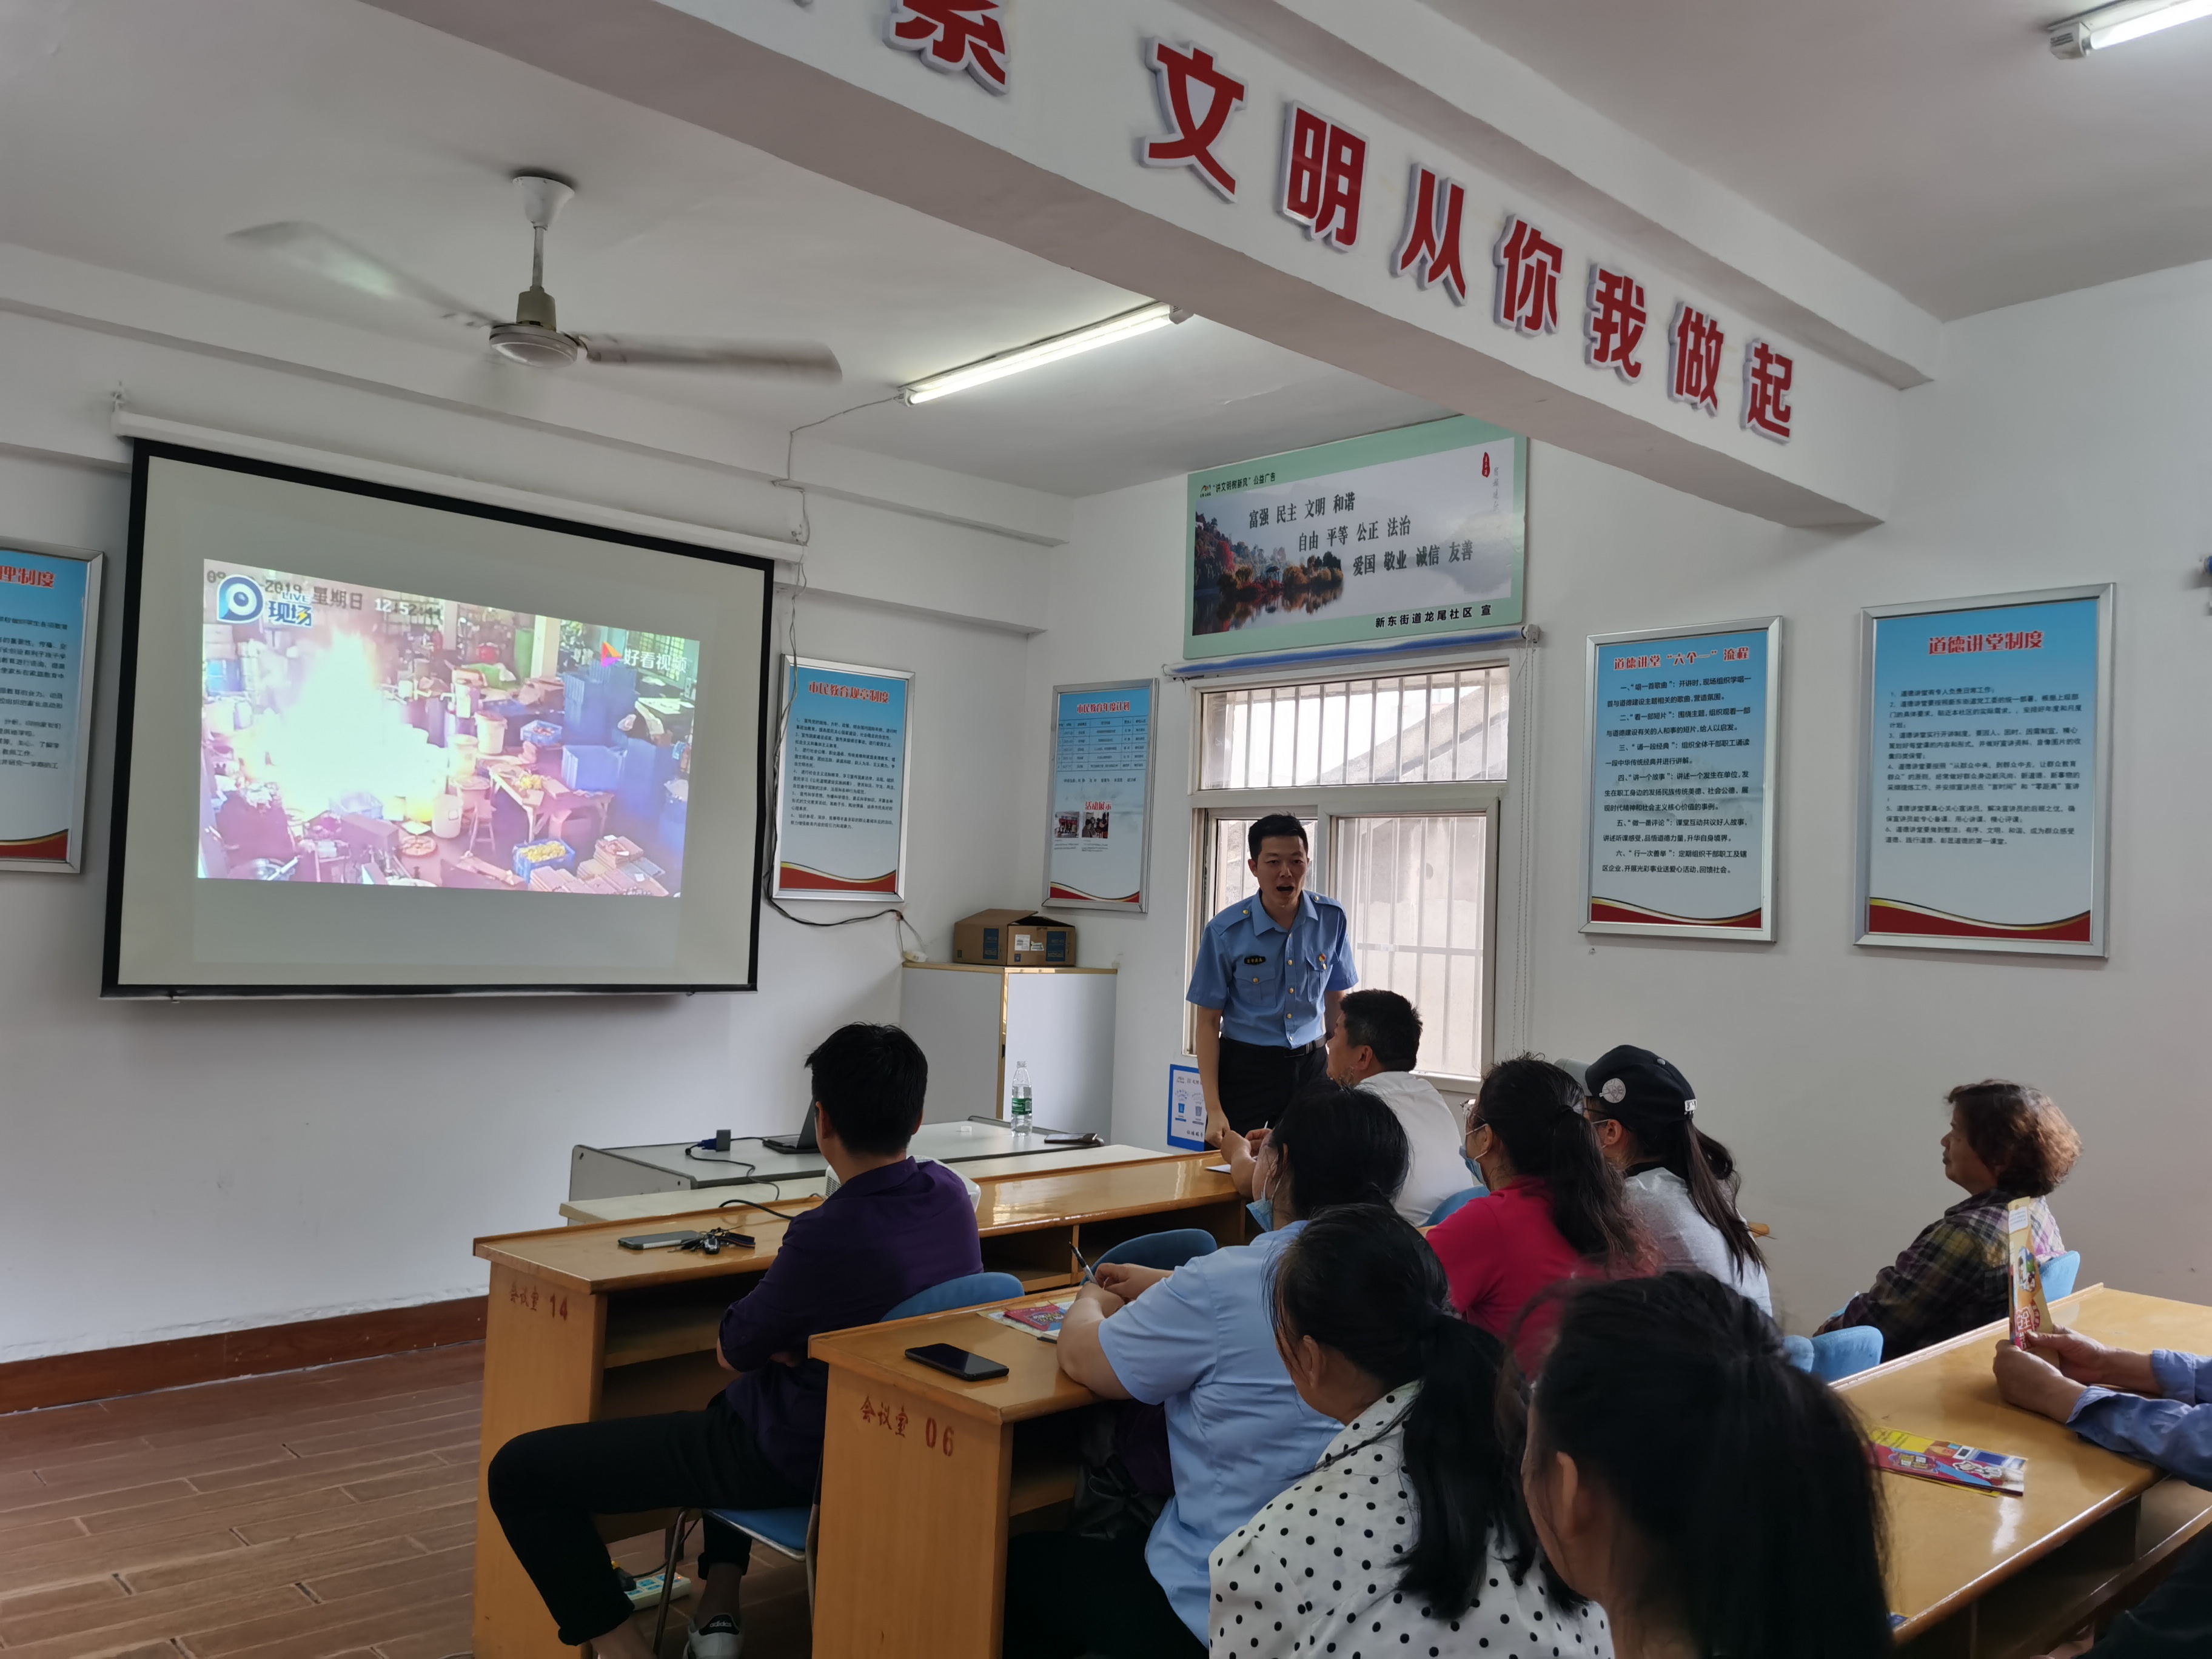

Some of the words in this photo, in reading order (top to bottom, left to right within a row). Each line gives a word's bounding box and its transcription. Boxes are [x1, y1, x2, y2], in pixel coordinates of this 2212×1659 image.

[1144, 40, 1795, 440] 文明从你我做起
[1249, 508, 1269, 529] 富强
[1276, 503, 1297, 524] 民主
[1304, 497, 1326, 520] 文明
[1333, 492, 1355, 514] 和谐
[1299, 531, 1319, 552] 自由
[1327, 525, 1349, 547] 平等
[1356, 520, 1379, 542] 公正
[1387, 515, 1411, 537] 法治
[1352, 554, 1375, 577] 爱国
[1384, 550, 1407, 571] 敬业
[1415, 545, 1440, 568] 诚信
[1448, 539, 1473, 563] 友善
[281, 592, 311, 602] LIVE
[312, 586, 363, 610] 星期日
[268, 600, 312, 627] 现场
[1375, 607, 1472, 628] 新东街道龙尾社区
[1481, 605, 1492, 616] 宣
[1928, 631, 2044, 655] 道德讲堂制度
[624, 647, 688, 673] 好看视频
[808, 681, 890, 703] 市民教育规章制度
[1085, 801, 1112, 811] 活动展示
[549, 1293, 568, 1322] 14
[925, 1417, 954, 1456] 06
